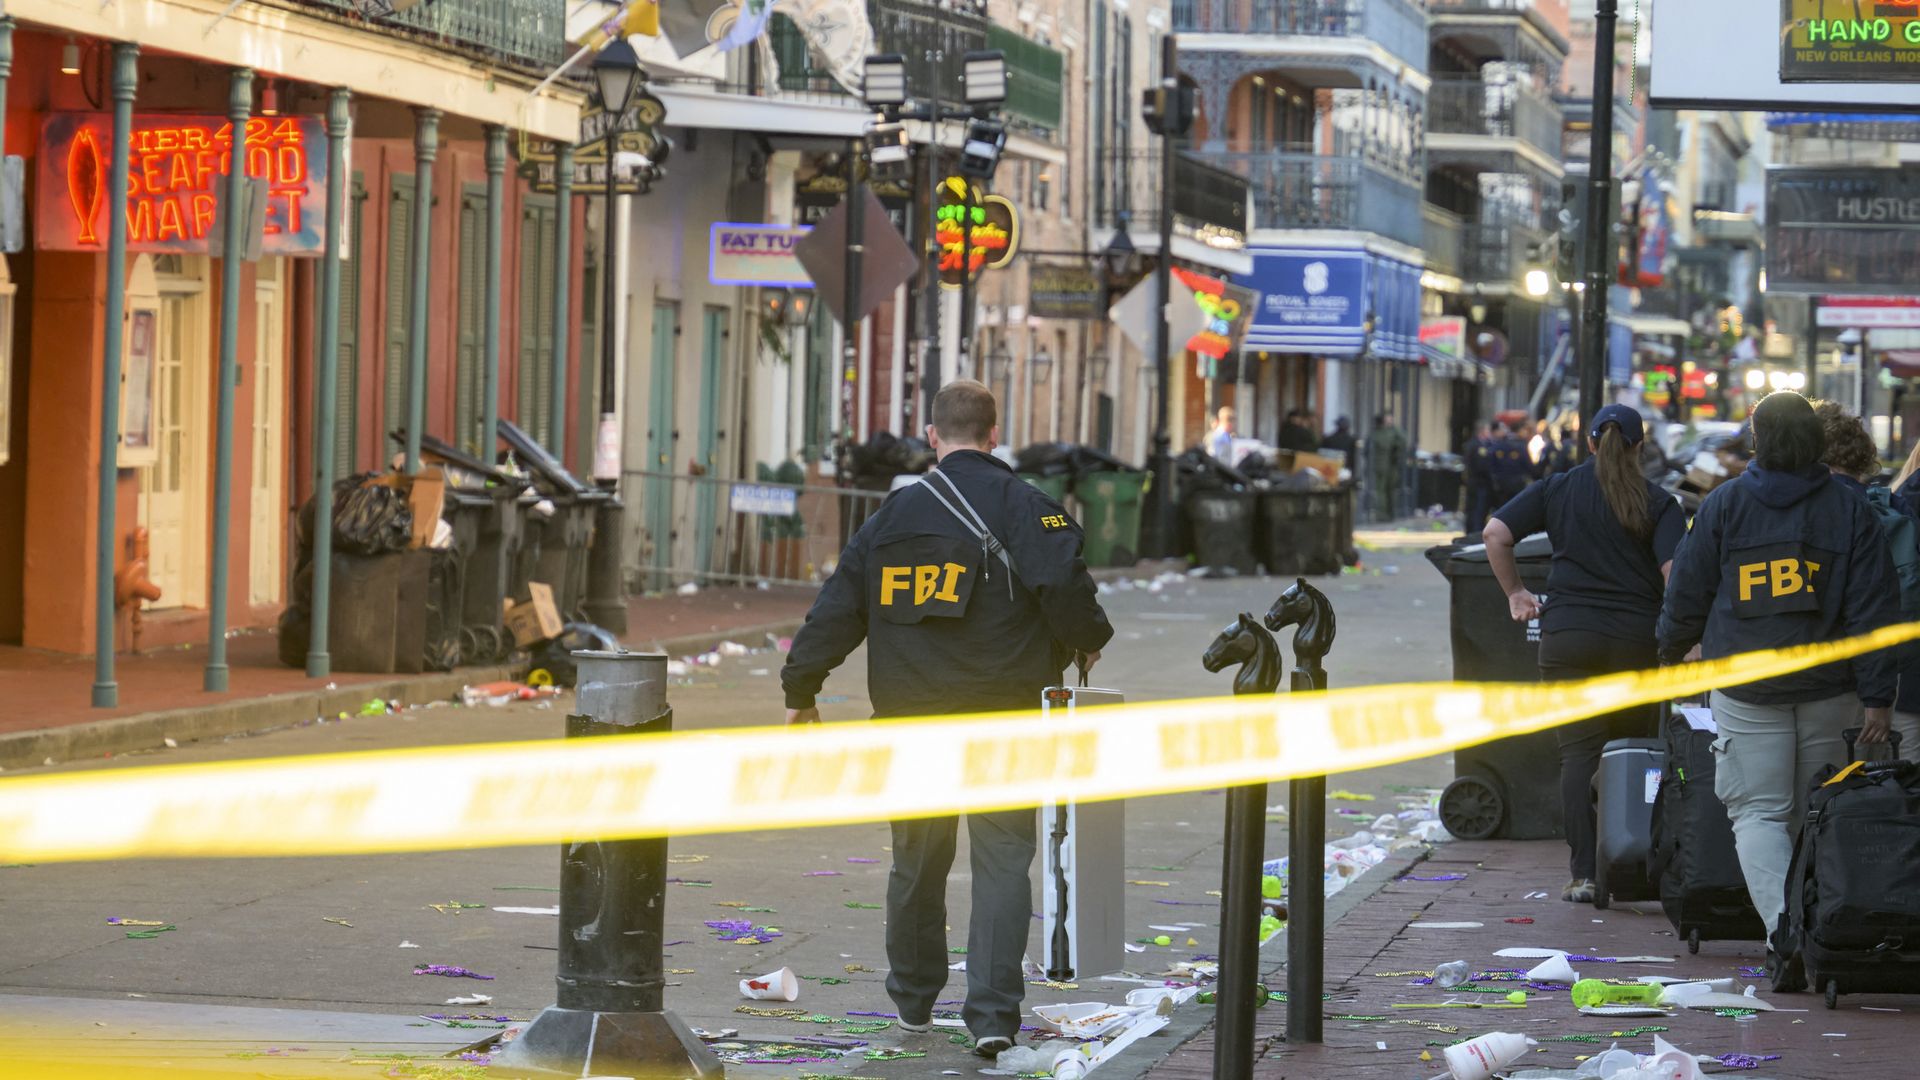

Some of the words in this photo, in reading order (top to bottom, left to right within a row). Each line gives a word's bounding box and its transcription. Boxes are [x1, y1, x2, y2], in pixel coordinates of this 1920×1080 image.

[1809, 19, 1890, 41] HAND
[1904, 20, 1920, 43] G
[1796, 50, 1826, 62] NEW
[1830, 51, 1892, 63] ORLEANS
[127, 128, 210, 153] IER
[126, 146, 305, 195] SEAFOD
[125, 188, 307, 241] MART
[721, 233, 759, 248] FAT
[1266, 294, 1305, 306] ROYAL
[1041, 514, 1068, 528] FBI
[880, 562, 967, 606] FBI
